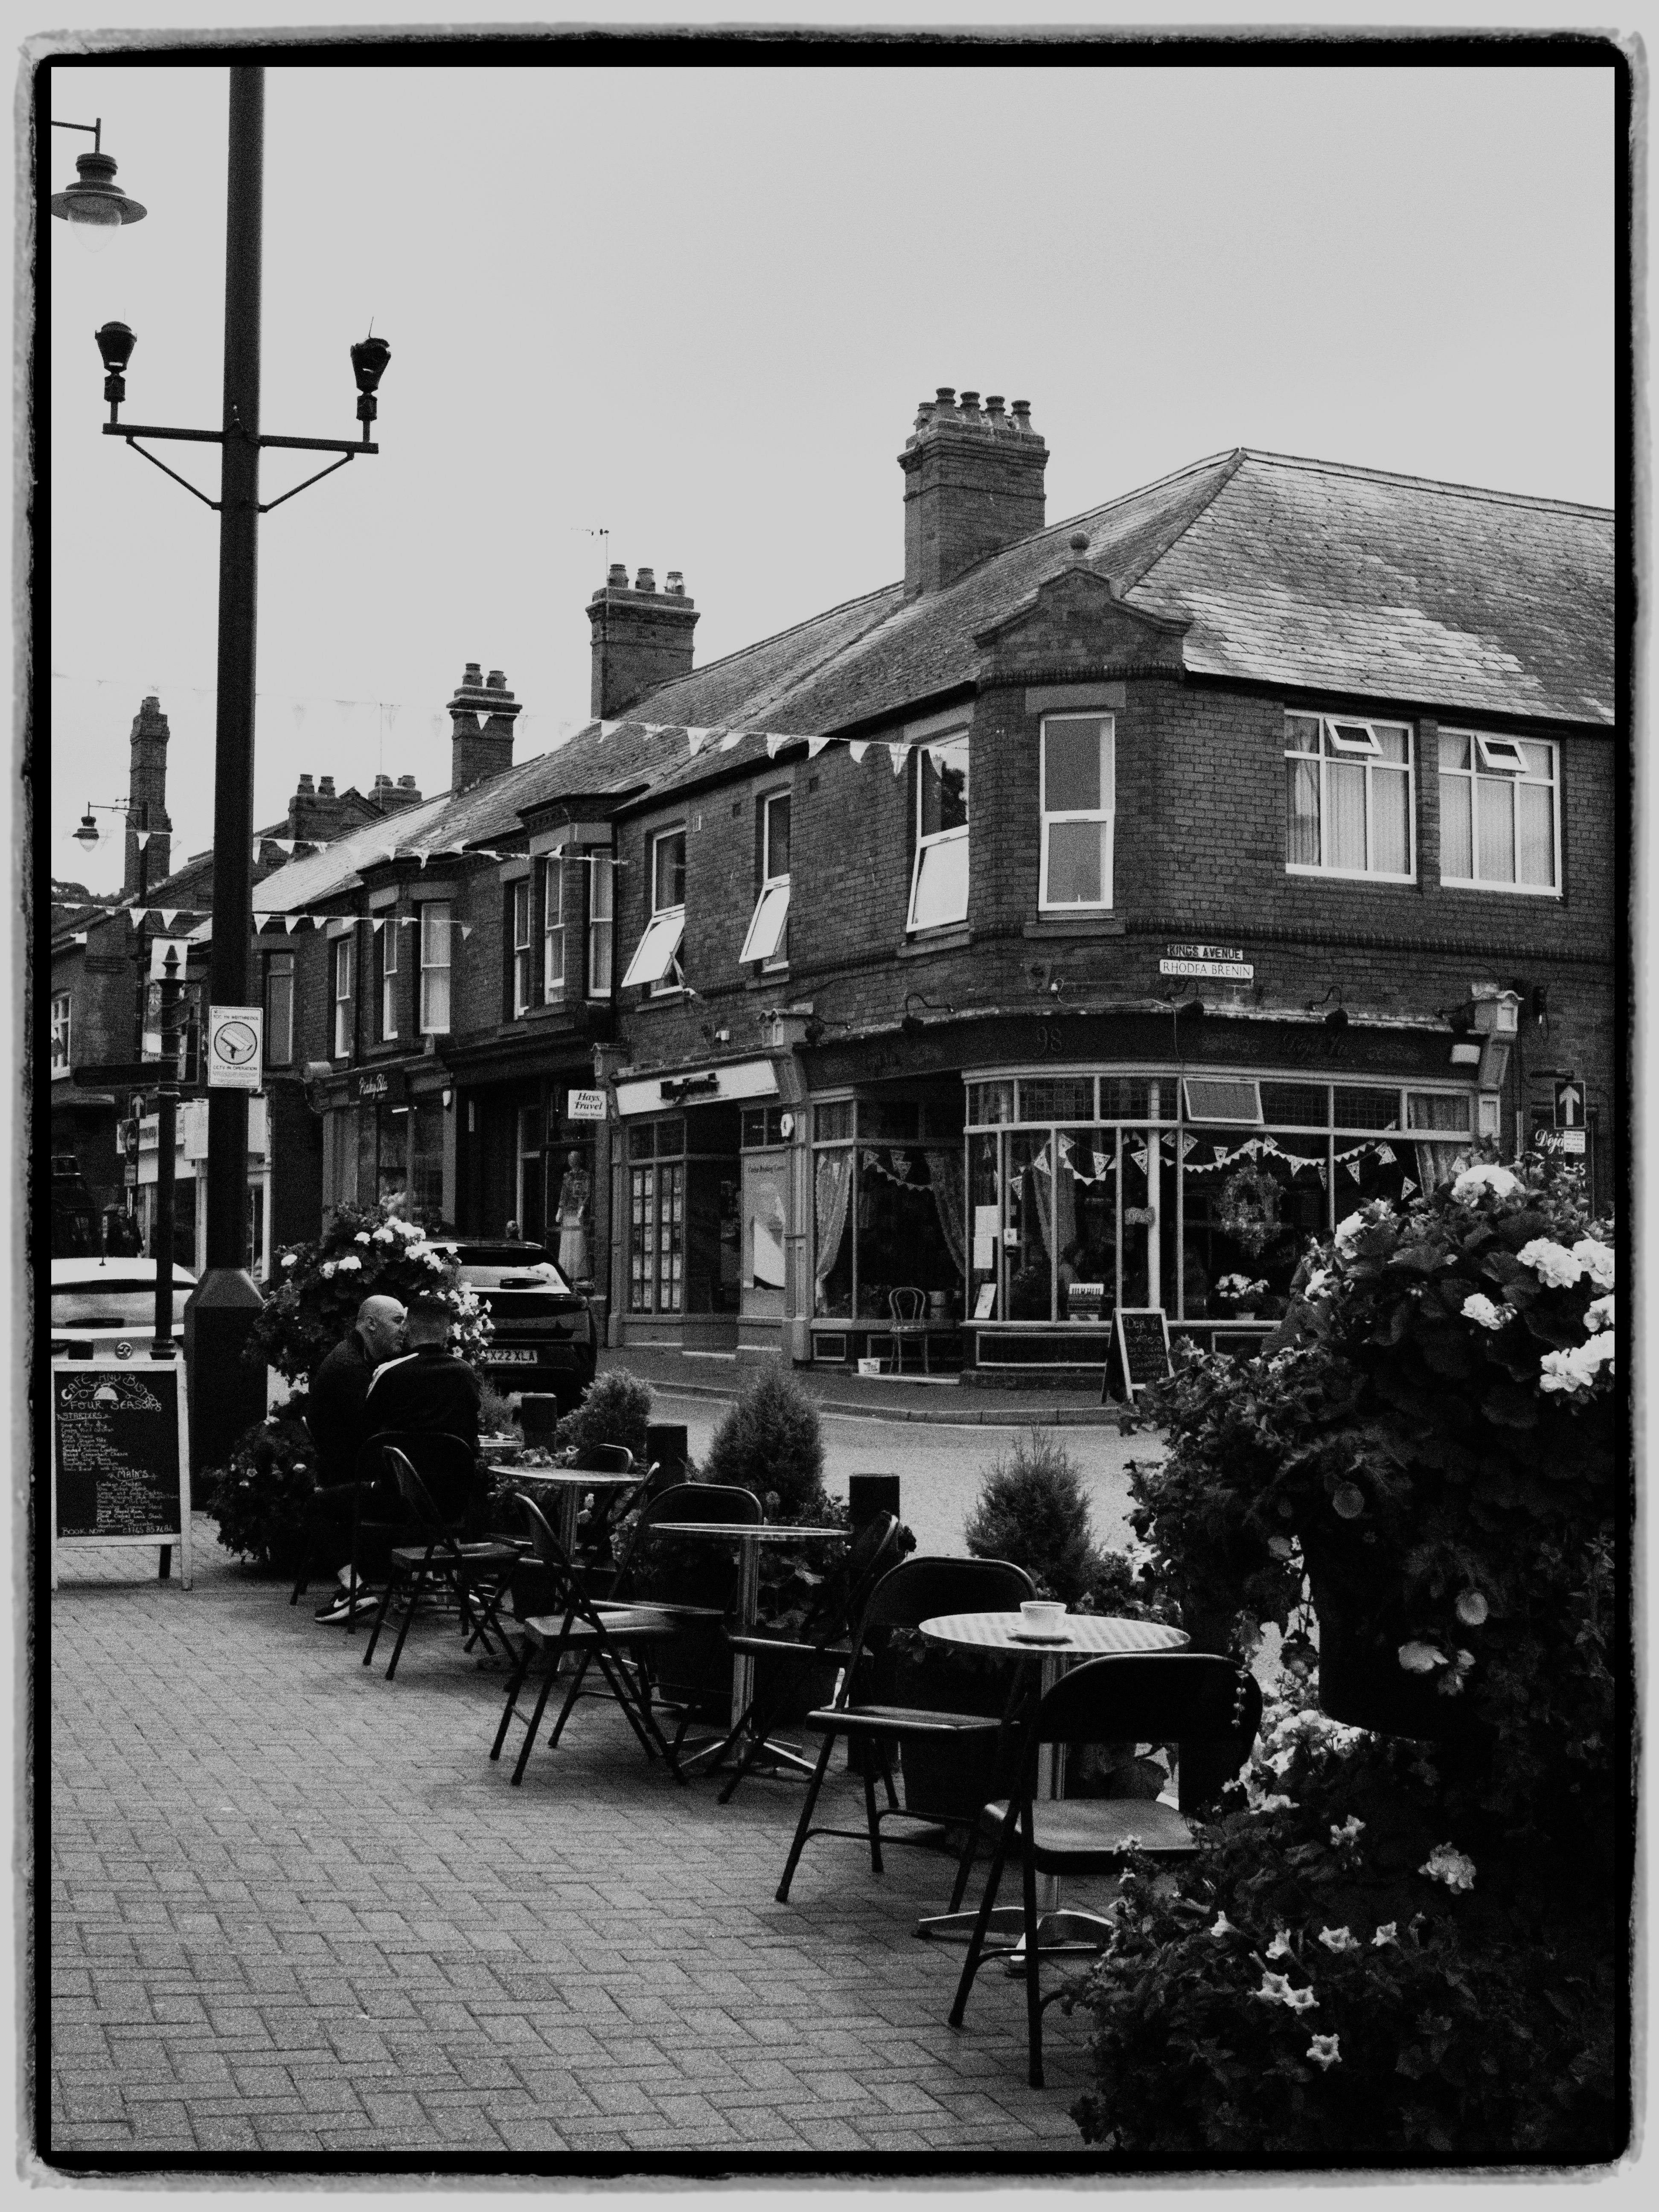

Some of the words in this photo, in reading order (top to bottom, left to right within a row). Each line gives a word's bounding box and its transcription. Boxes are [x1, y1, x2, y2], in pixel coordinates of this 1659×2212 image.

[1169, 946, 1199, 957] KINGS
[1202, 947, 1241, 959] AVENUE
[1163, 962, 1207, 974] RHODFA
[1212, 964, 1250, 976] BRENIN
[1033, 1026, 1062, 1057] 98
[578, 1092, 600, 1103] Hays
[575, 1101, 603, 1110] Travel
[485, 1350, 512, 1361] X22
[514, 1351, 535, 1361] XLA
[61, 1373, 91, 1400] CAFE
[99, 1373, 121, 1383] AND
[70, 1400, 104, 1410] FOUR
